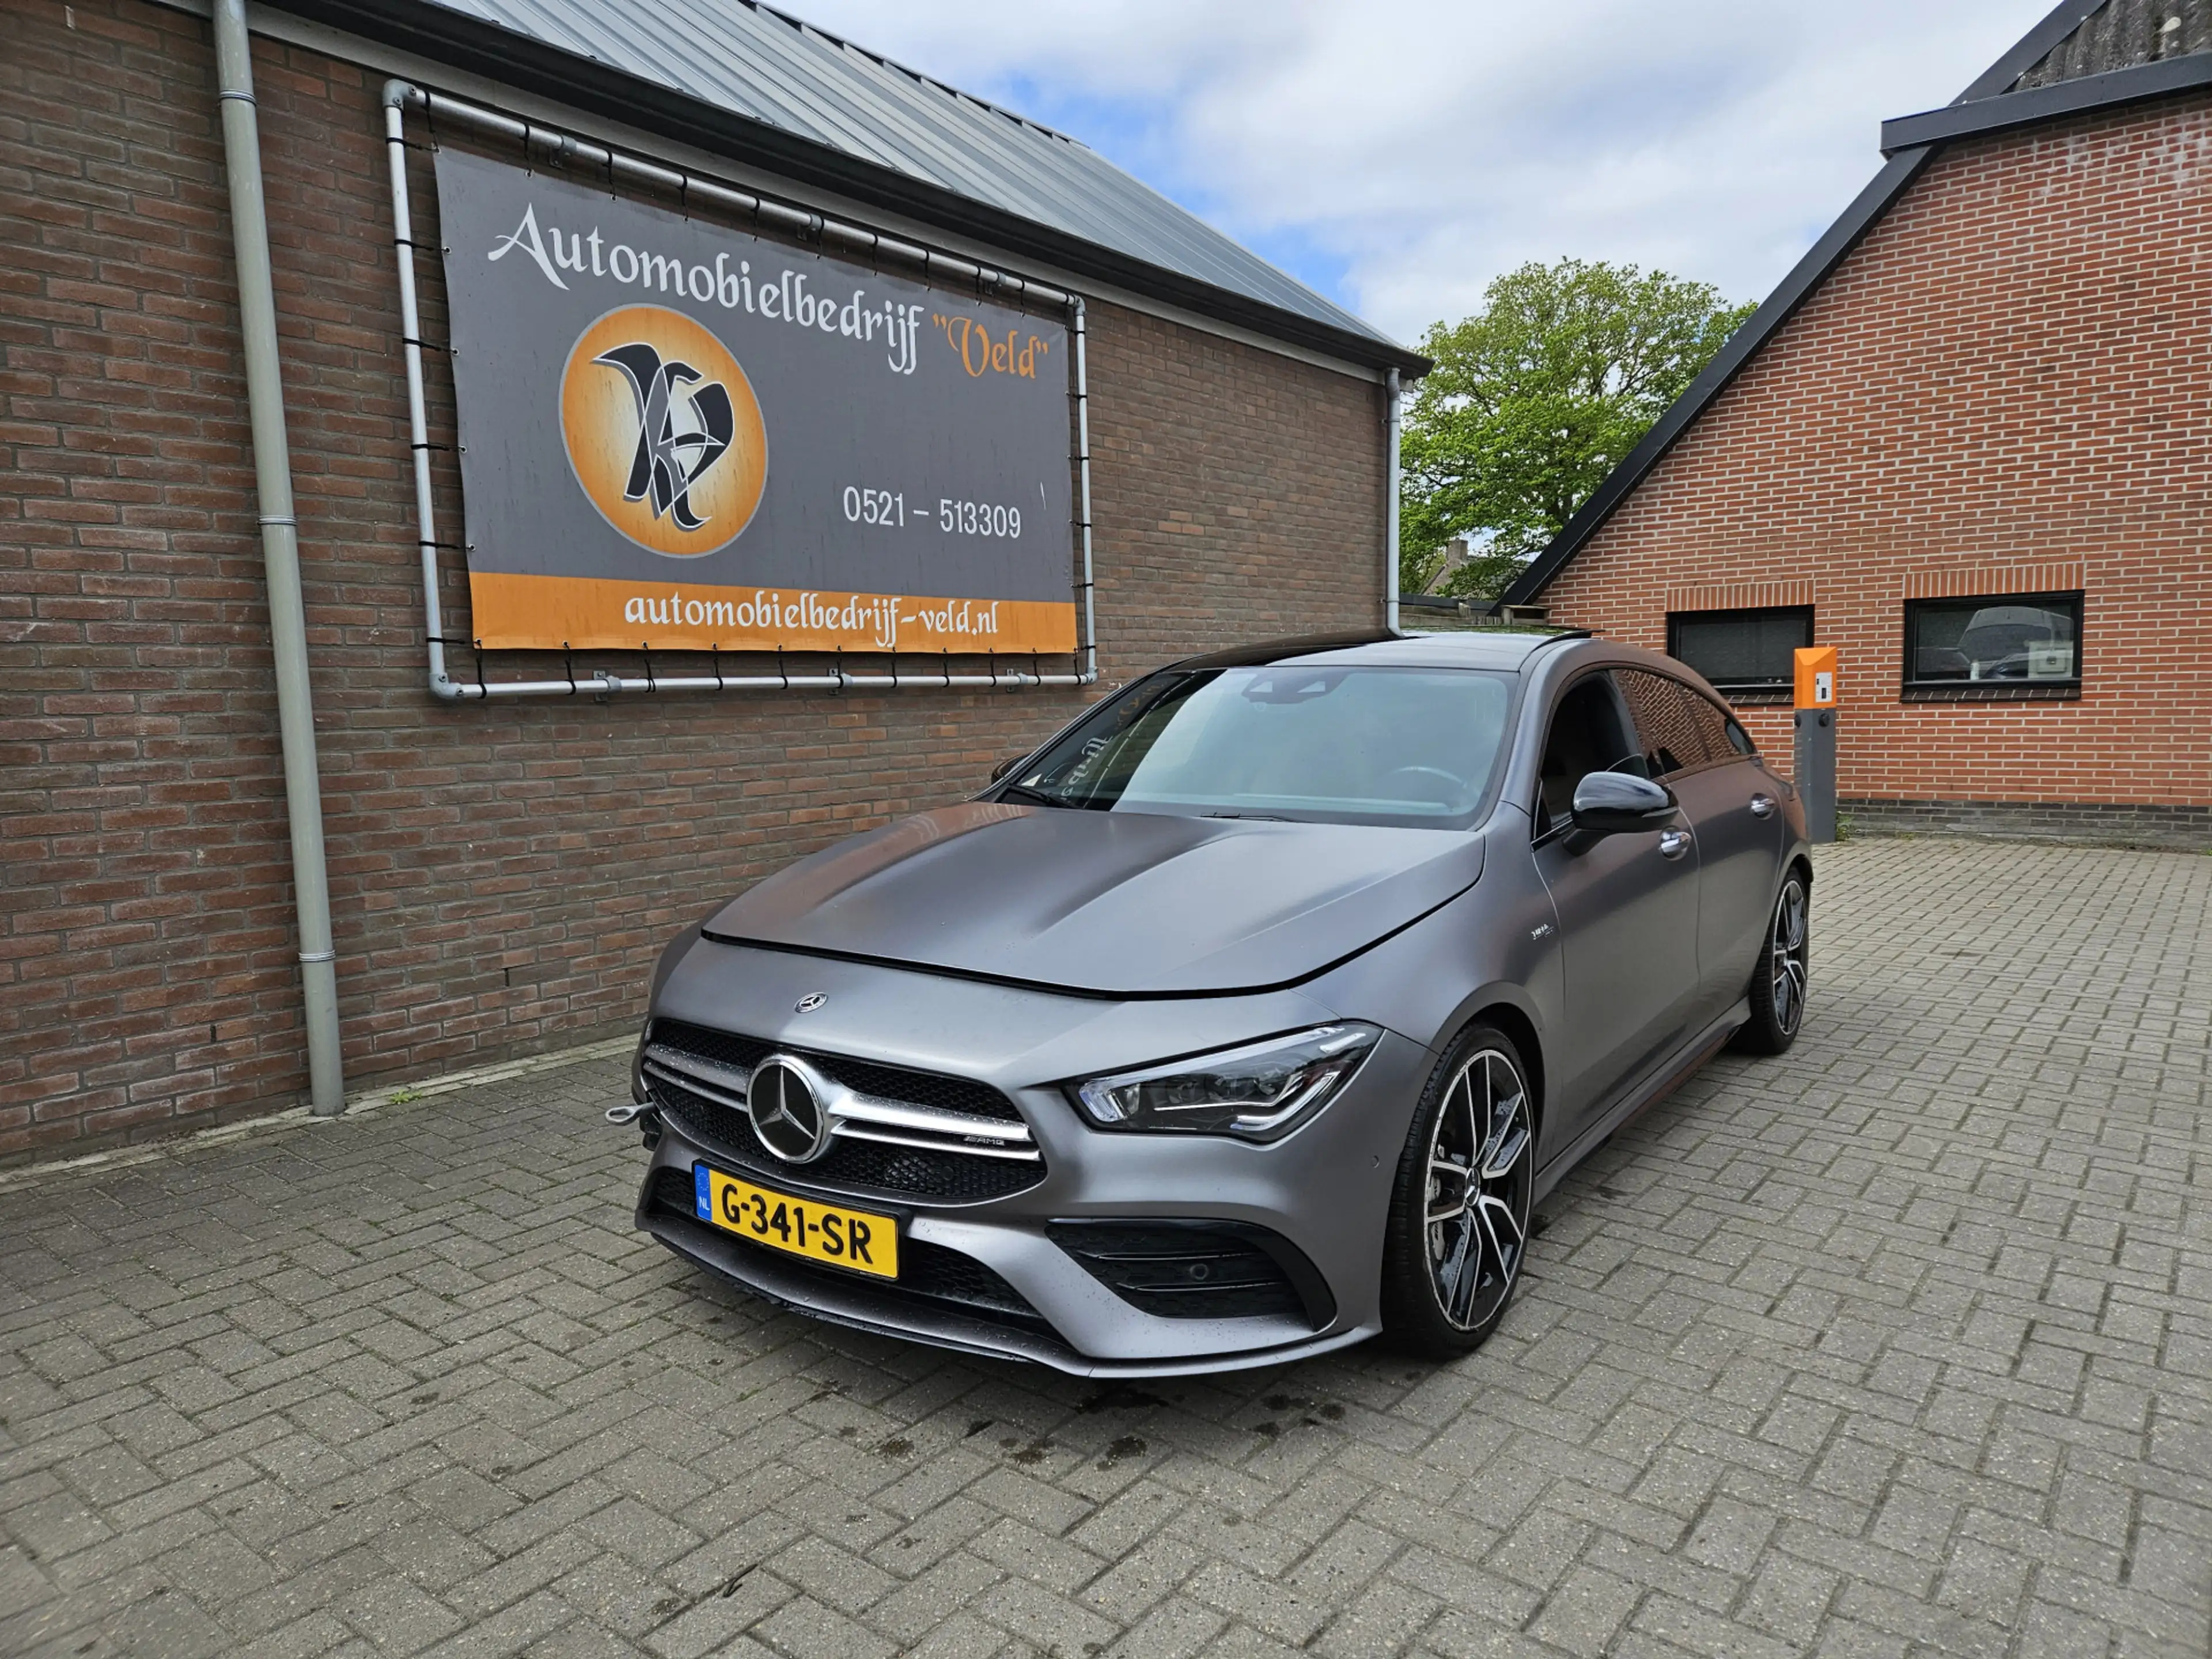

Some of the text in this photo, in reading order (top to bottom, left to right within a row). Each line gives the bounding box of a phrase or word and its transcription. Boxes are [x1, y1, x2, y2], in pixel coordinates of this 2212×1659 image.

[487, 202, 1049, 379] Automobielbedrijf "Veld"
[843, 486, 904, 527] 0521
[940, 498, 1021, 539] 513309
[624, 591, 999, 647] automobielbedrijf-veld.nl
[698, 1196, 710, 1211] NL
[722, 1183, 873, 1265] G-341-SR
